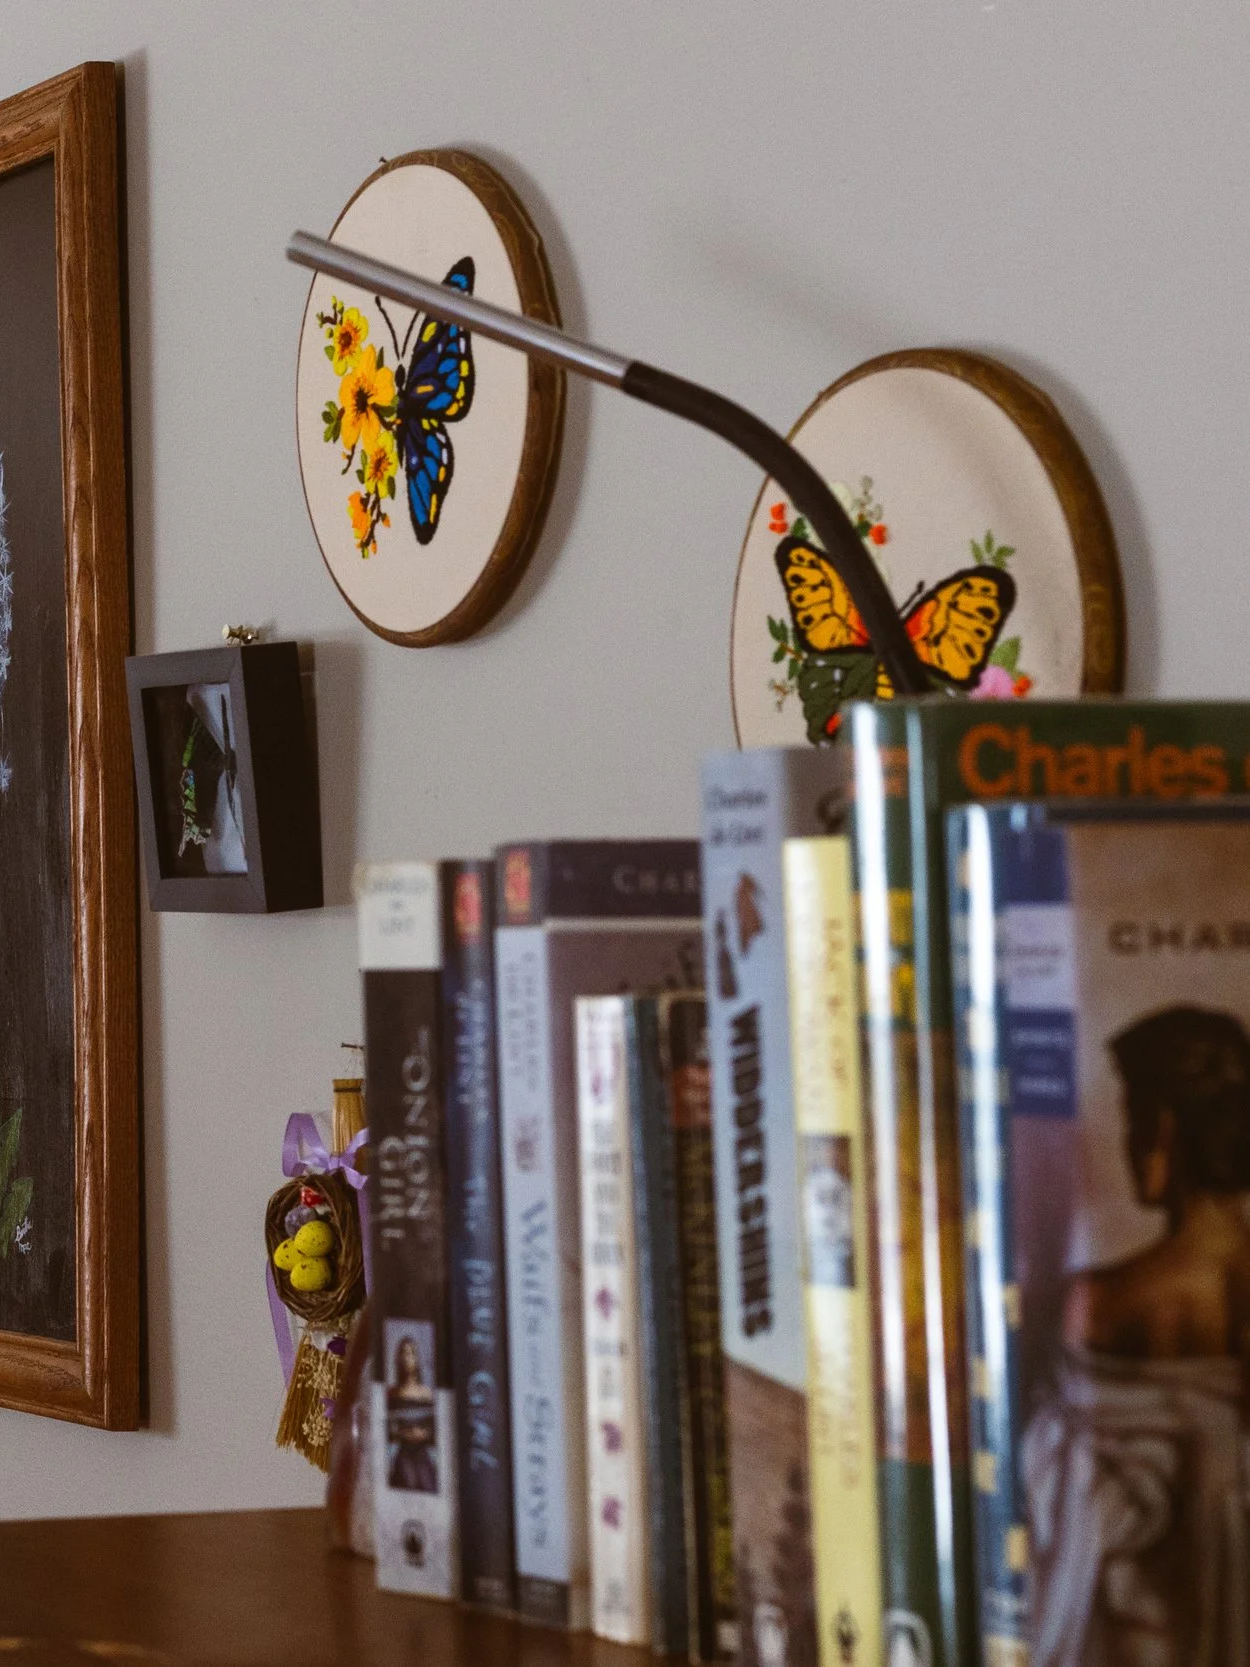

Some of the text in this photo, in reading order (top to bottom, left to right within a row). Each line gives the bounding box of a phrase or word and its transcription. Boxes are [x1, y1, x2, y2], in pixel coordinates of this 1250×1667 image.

[957, 723, 1229, 799] Charles
[379, 1135, 406, 1239] GIRL
[402, 1053, 432, 1221] ONION
[729, 1004, 774, 1338] WIDDERSHINS
